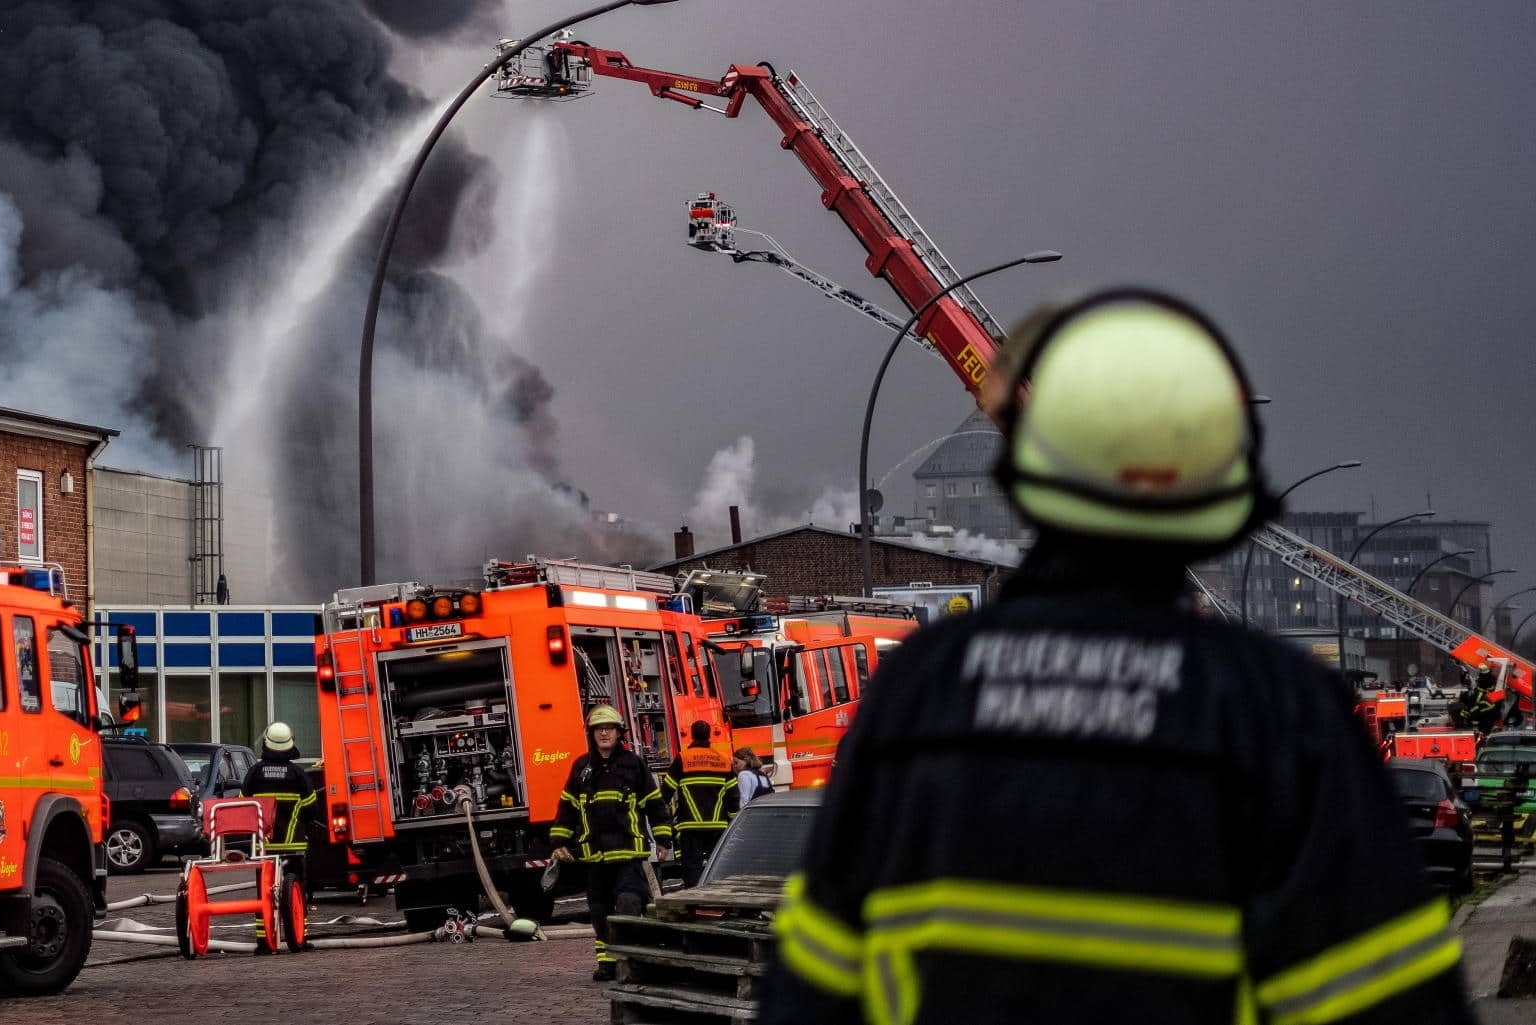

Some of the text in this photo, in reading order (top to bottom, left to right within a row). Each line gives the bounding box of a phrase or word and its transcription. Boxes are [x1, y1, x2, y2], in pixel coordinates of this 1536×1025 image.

[415, 624, 456, 639] HH 2564
[962, 632, 1184, 692] FEUERWEHR
[973, 683, 1158, 741] HAMBURG
